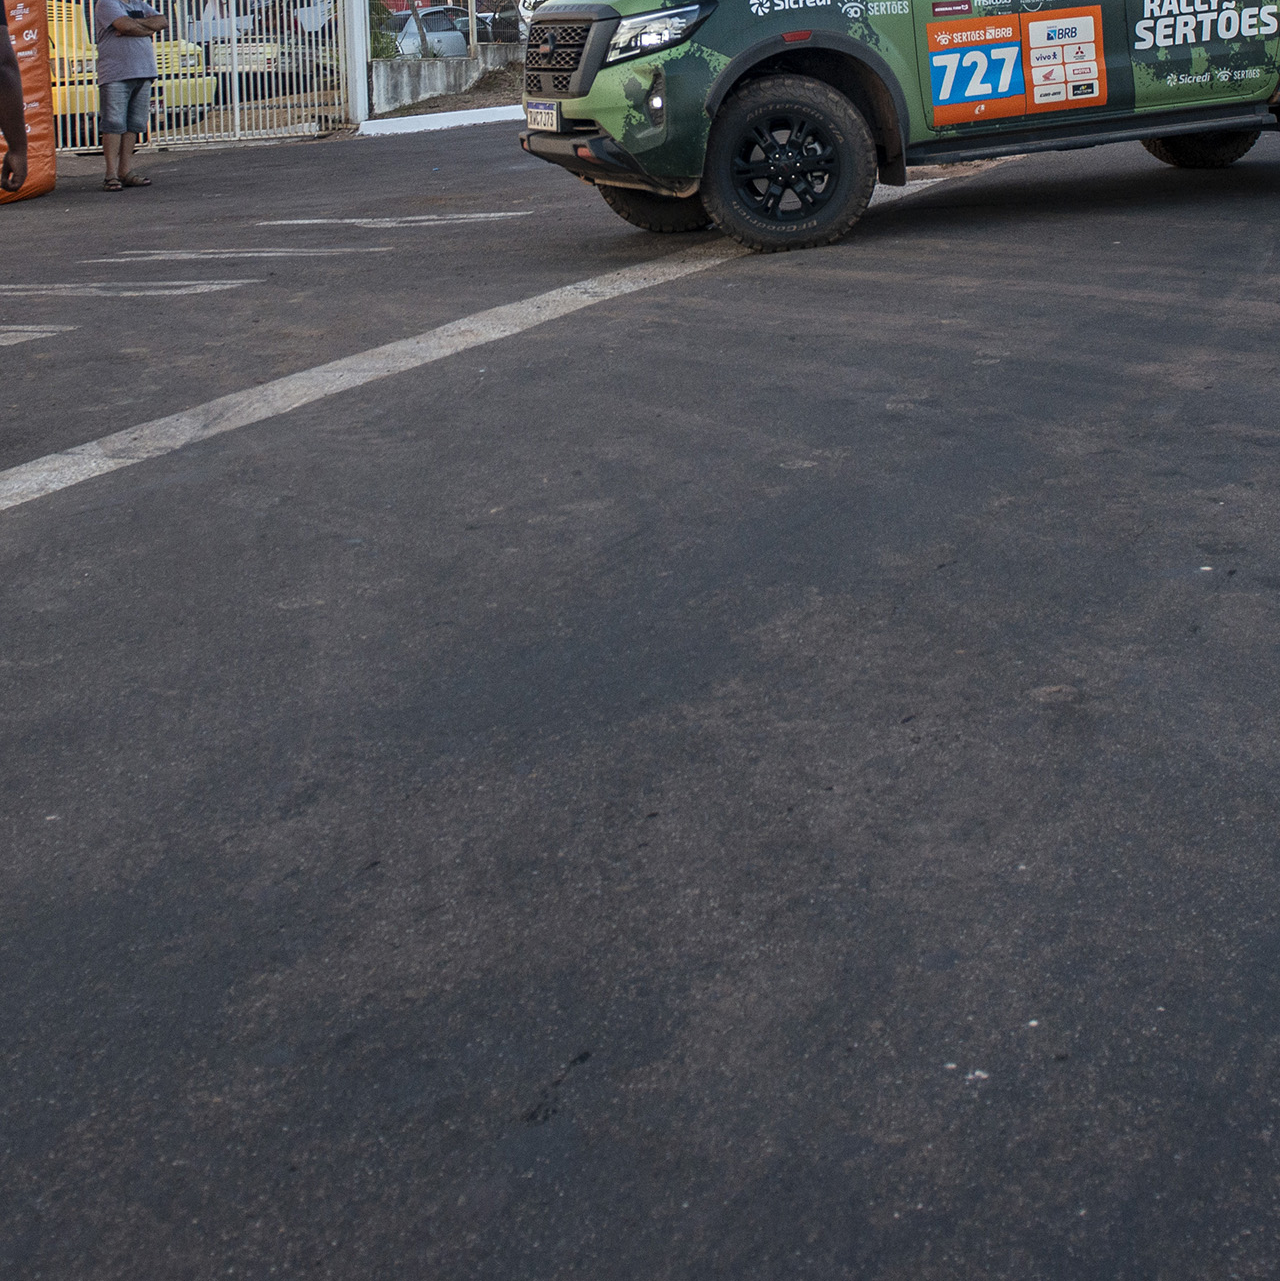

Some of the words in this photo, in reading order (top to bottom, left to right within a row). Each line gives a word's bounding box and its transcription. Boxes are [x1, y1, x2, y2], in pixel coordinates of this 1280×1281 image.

[1134, 1, 1278, 50] SERTÕES
[995, 27, 1013, 39] BRB
[1057, 27, 1077, 39] BRB
[1035, 53, 1051, 62] vivo
[932, 46, 1019, 100] 727
[1179, 72, 1211, 84] Sicredi
